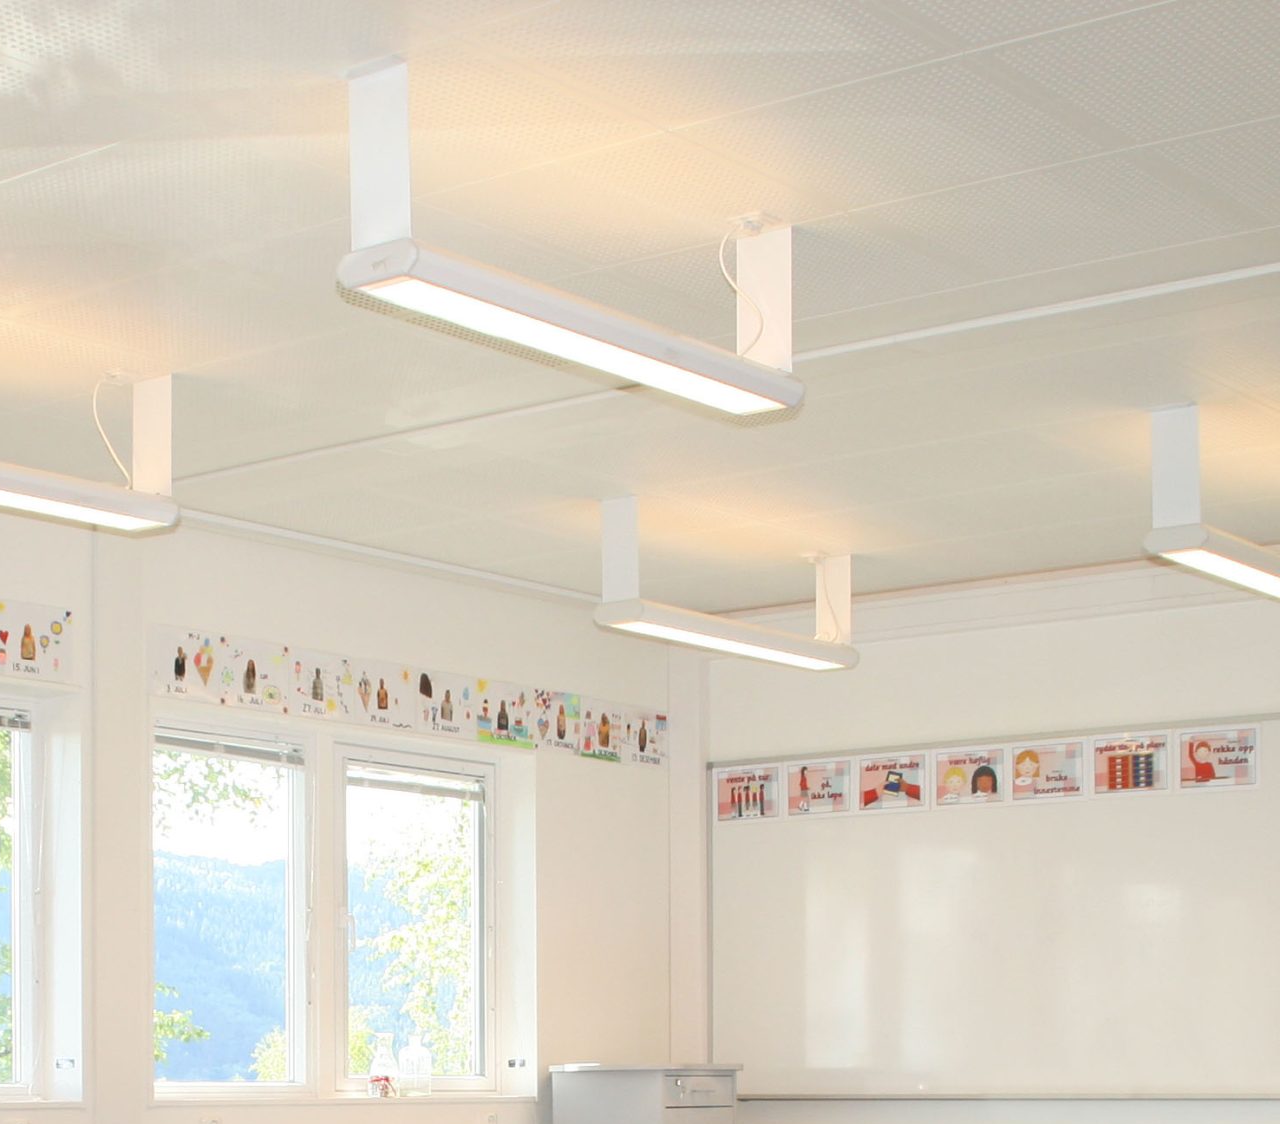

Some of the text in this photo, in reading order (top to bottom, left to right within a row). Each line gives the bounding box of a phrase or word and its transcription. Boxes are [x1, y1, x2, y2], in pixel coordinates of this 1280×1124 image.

[23, 665, 40, 675] JUNI
[1213, 744, 1254, 754] rekke opp
[747, 773, 757, 784] på
